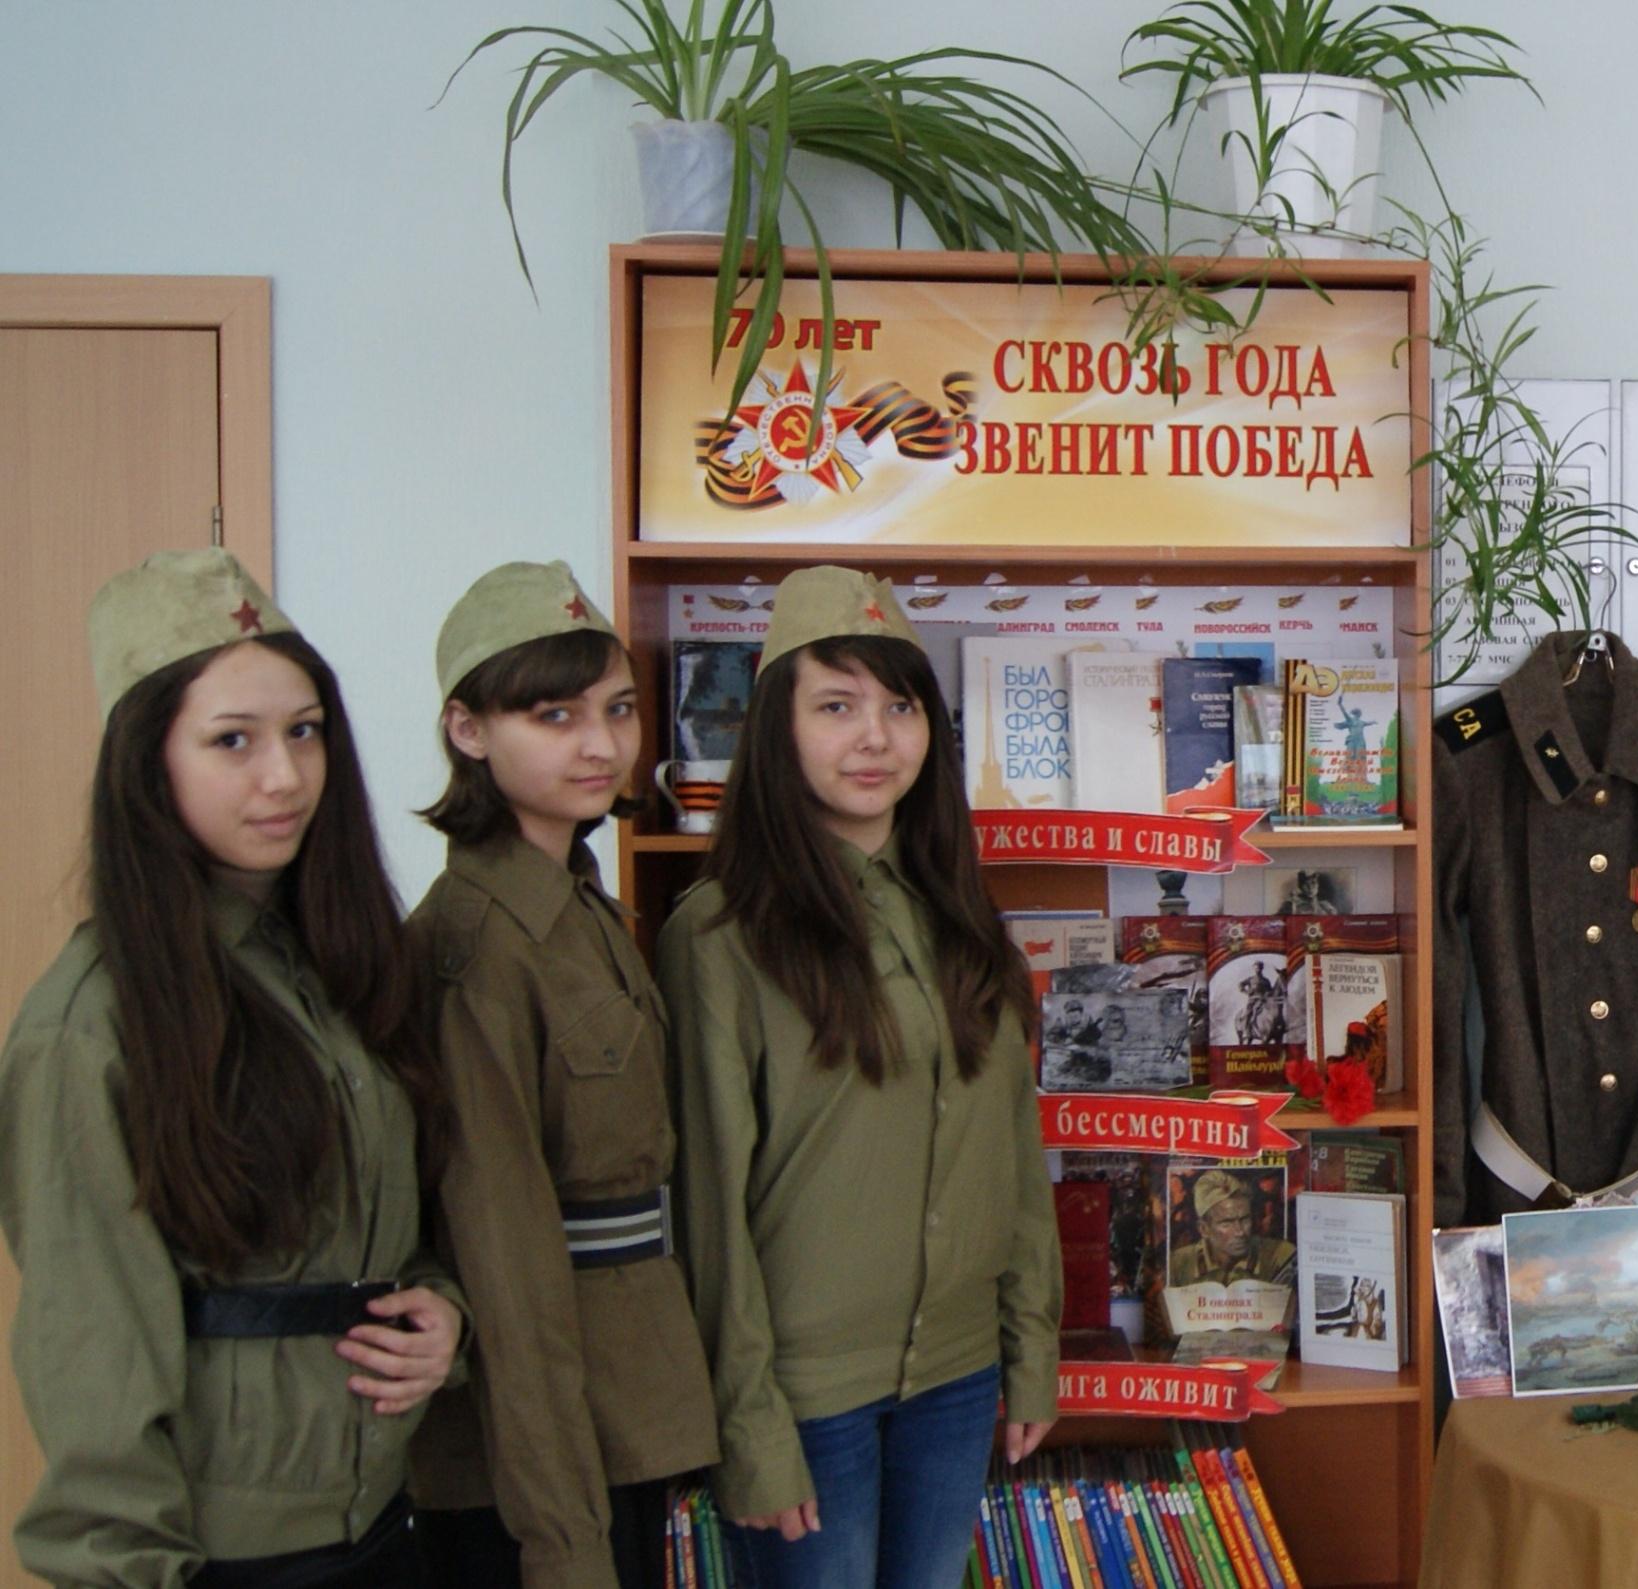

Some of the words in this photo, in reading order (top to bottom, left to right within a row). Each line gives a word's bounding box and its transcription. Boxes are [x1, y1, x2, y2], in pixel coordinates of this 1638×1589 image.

[726, 308, 785, 349] 70
[795, 318, 881, 350] лет
[993, 339, 1192, 396] СКВОЗЬ
[1205, 343, 1337, 410] ГОДА
[955, 421, 1154, 476] ЗВЕНИТ
[1168, 424, 1374, 492] ПОБЕДА
[1065, 621, 1120, 632] СМОЛЕНСК
[1136, 622, 1163, 632] ТУЛА
[1194, 622, 1272, 634] НОВОРОССИЙСК
[1339, 622, 1378, 633] МАНСК
[1004, 665, 1052, 687] БЫЛ
[1453, 707, 1482, 740] СА
[1006, 735, 1071, 757] БЫЛА
[1107, 828, 1123, 851] и
[1134, 826, 1222, 863] славы
[1057, 1100, 1249, 1151] бессмертны
[1120, 1377, 1237, 1410] оживит
